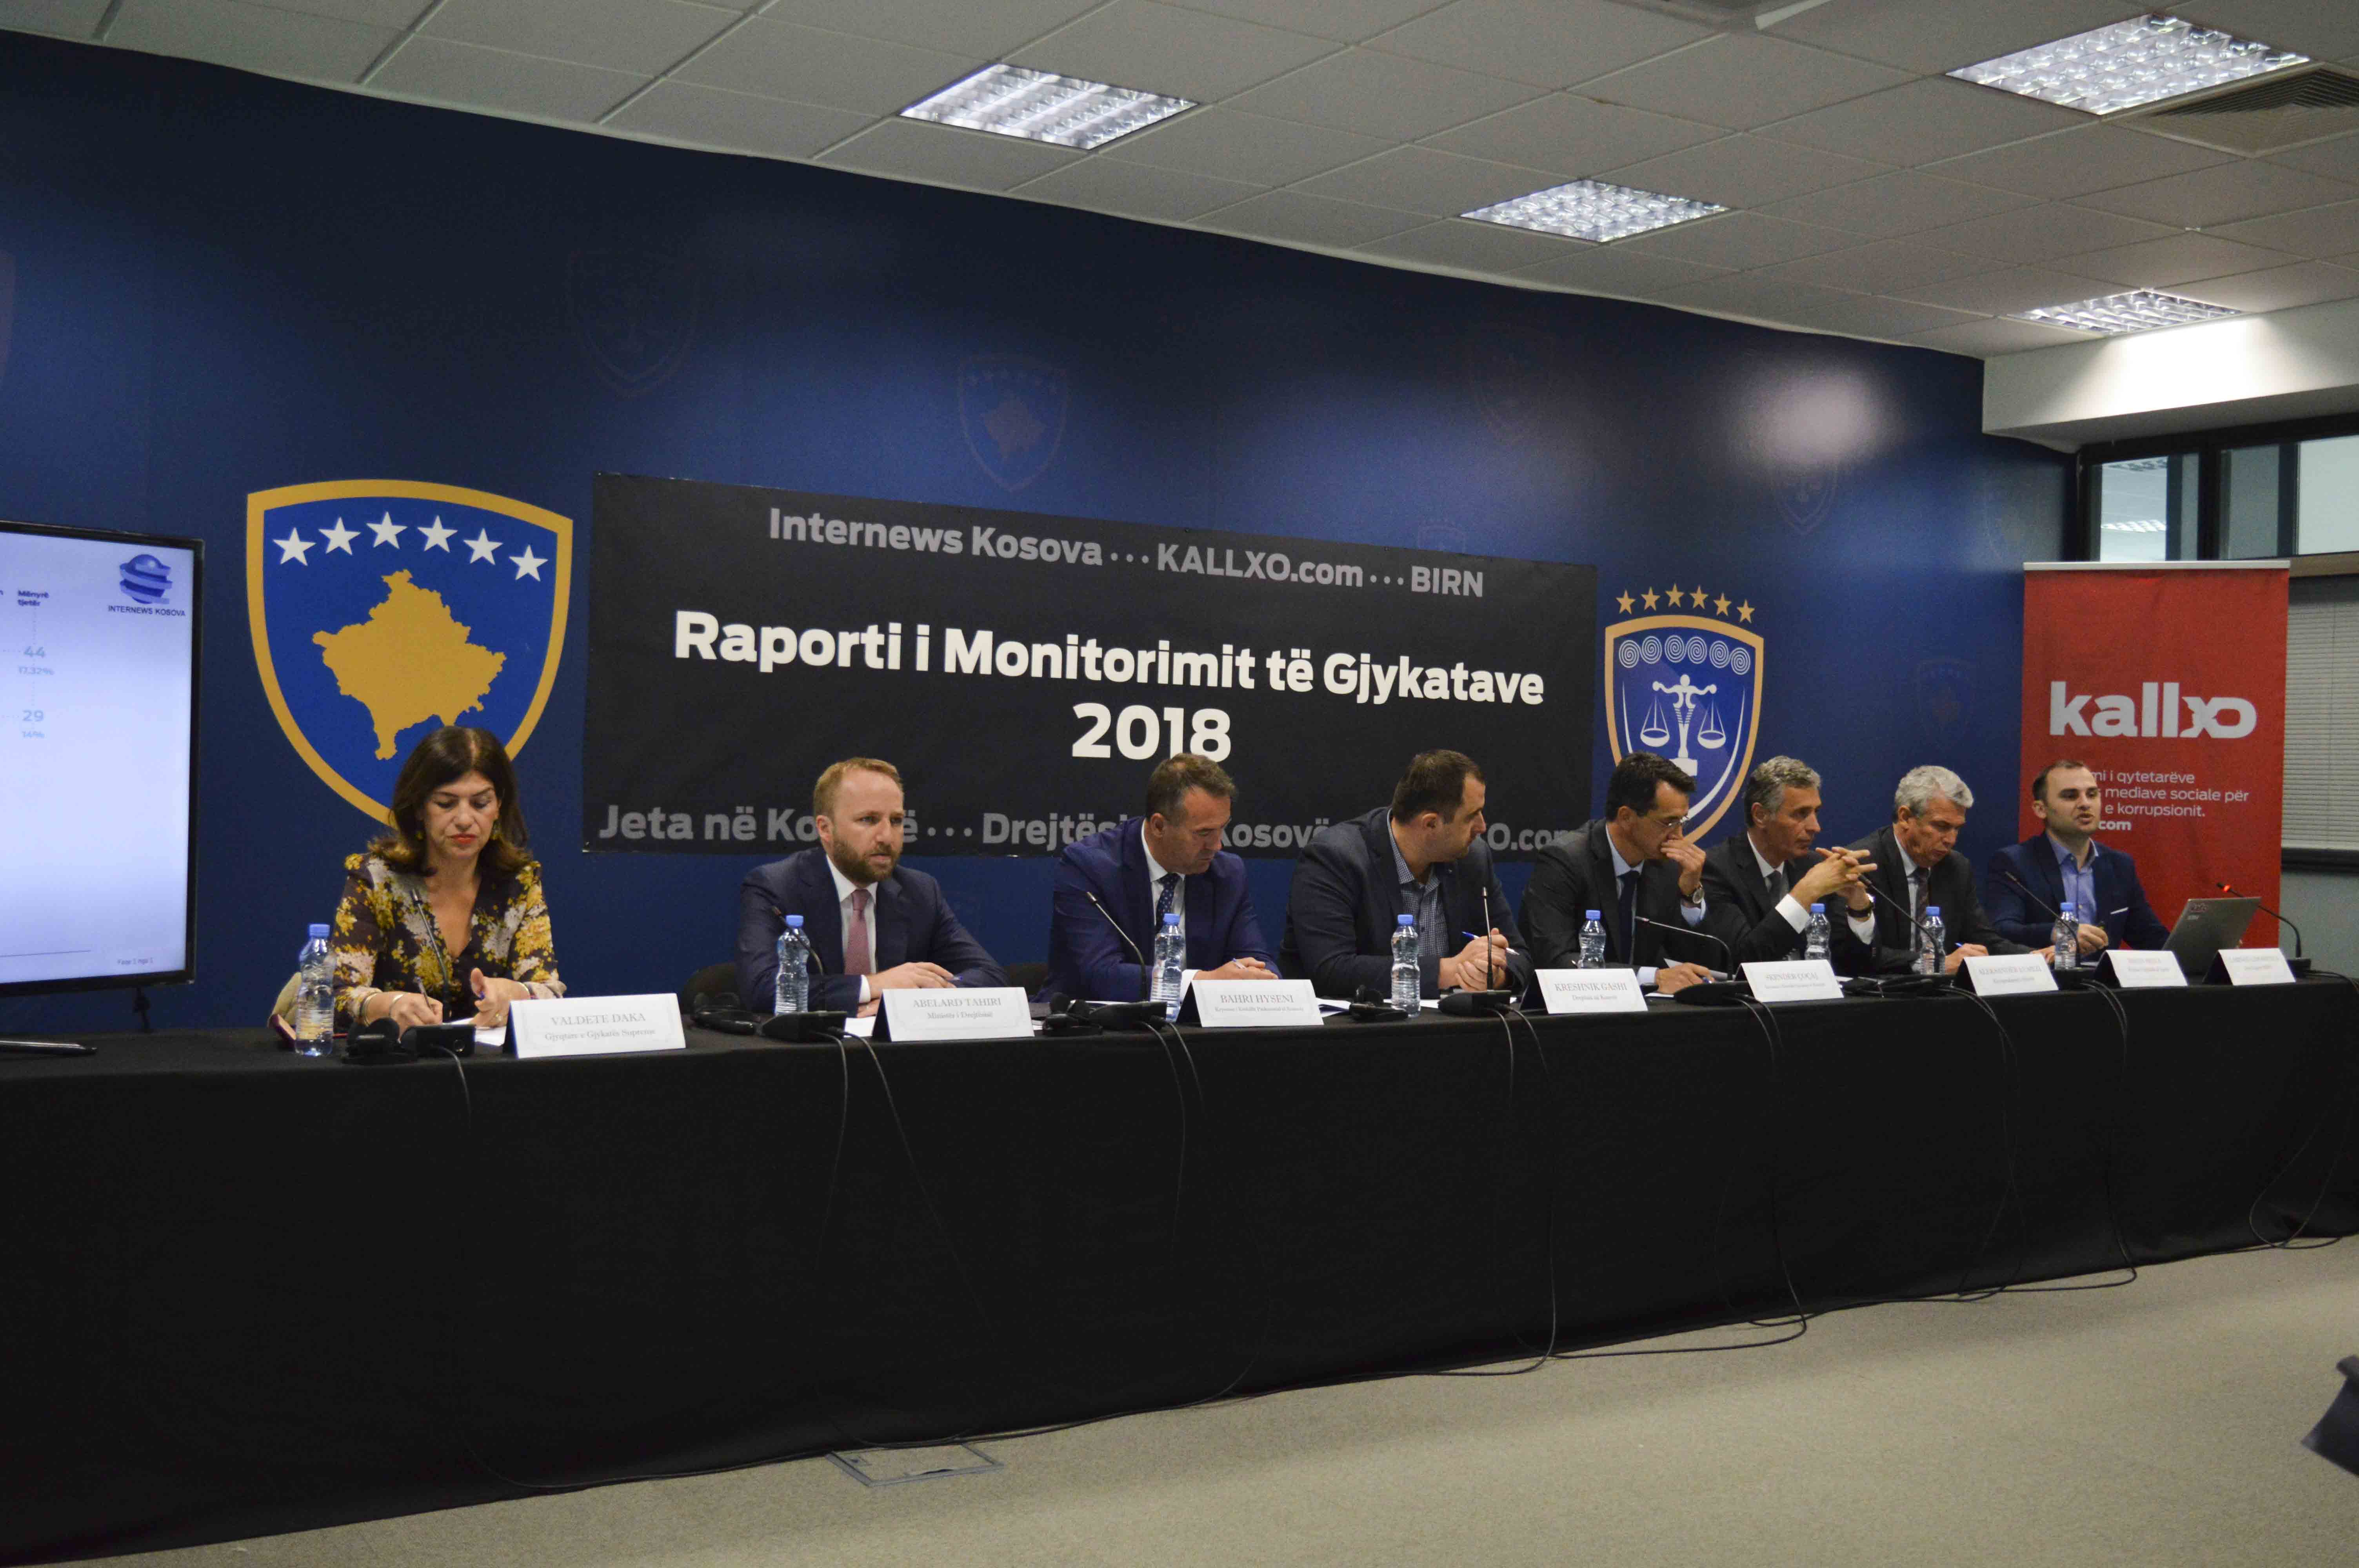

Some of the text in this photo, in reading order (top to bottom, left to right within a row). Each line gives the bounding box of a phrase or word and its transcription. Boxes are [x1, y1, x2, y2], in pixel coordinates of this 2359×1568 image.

[770, 508, 1483, 597] Internews Kosova KALLXO.com BIRN
[108, 605, 186, 616] INTERNEWS KOSOVA
[23, 646, 45, 658] 44
[675, 610, 1544, 705] Raporti i Monitorimit të Gjykatave
[22, 710, 44, 722] 29
[2050, 681, 2257, 739] kallxo
[1072, 702, 1231, 762] 2018
[2117, 771, 2195, 784] qytetarëve
[2105, 786, 2166, 799] mediave
[2170, 788, 2221, 801] sociale
[2225, 790, 2249, 803] për
[2105, 802, 2205, 817] e korrupsionit.
[599, 805, 693, 840] Jeta
[705, 806, 757, 841] në
[1554, 982, 1627, 991] KRESHNIK GASHI
[913, 998, 1001, 1007] ABELARD TAHIRI
[1220, 994, 1294, 1003] BAHRI HYSENI
[551, 1013, 646, 1026] VALDETE DAKA
